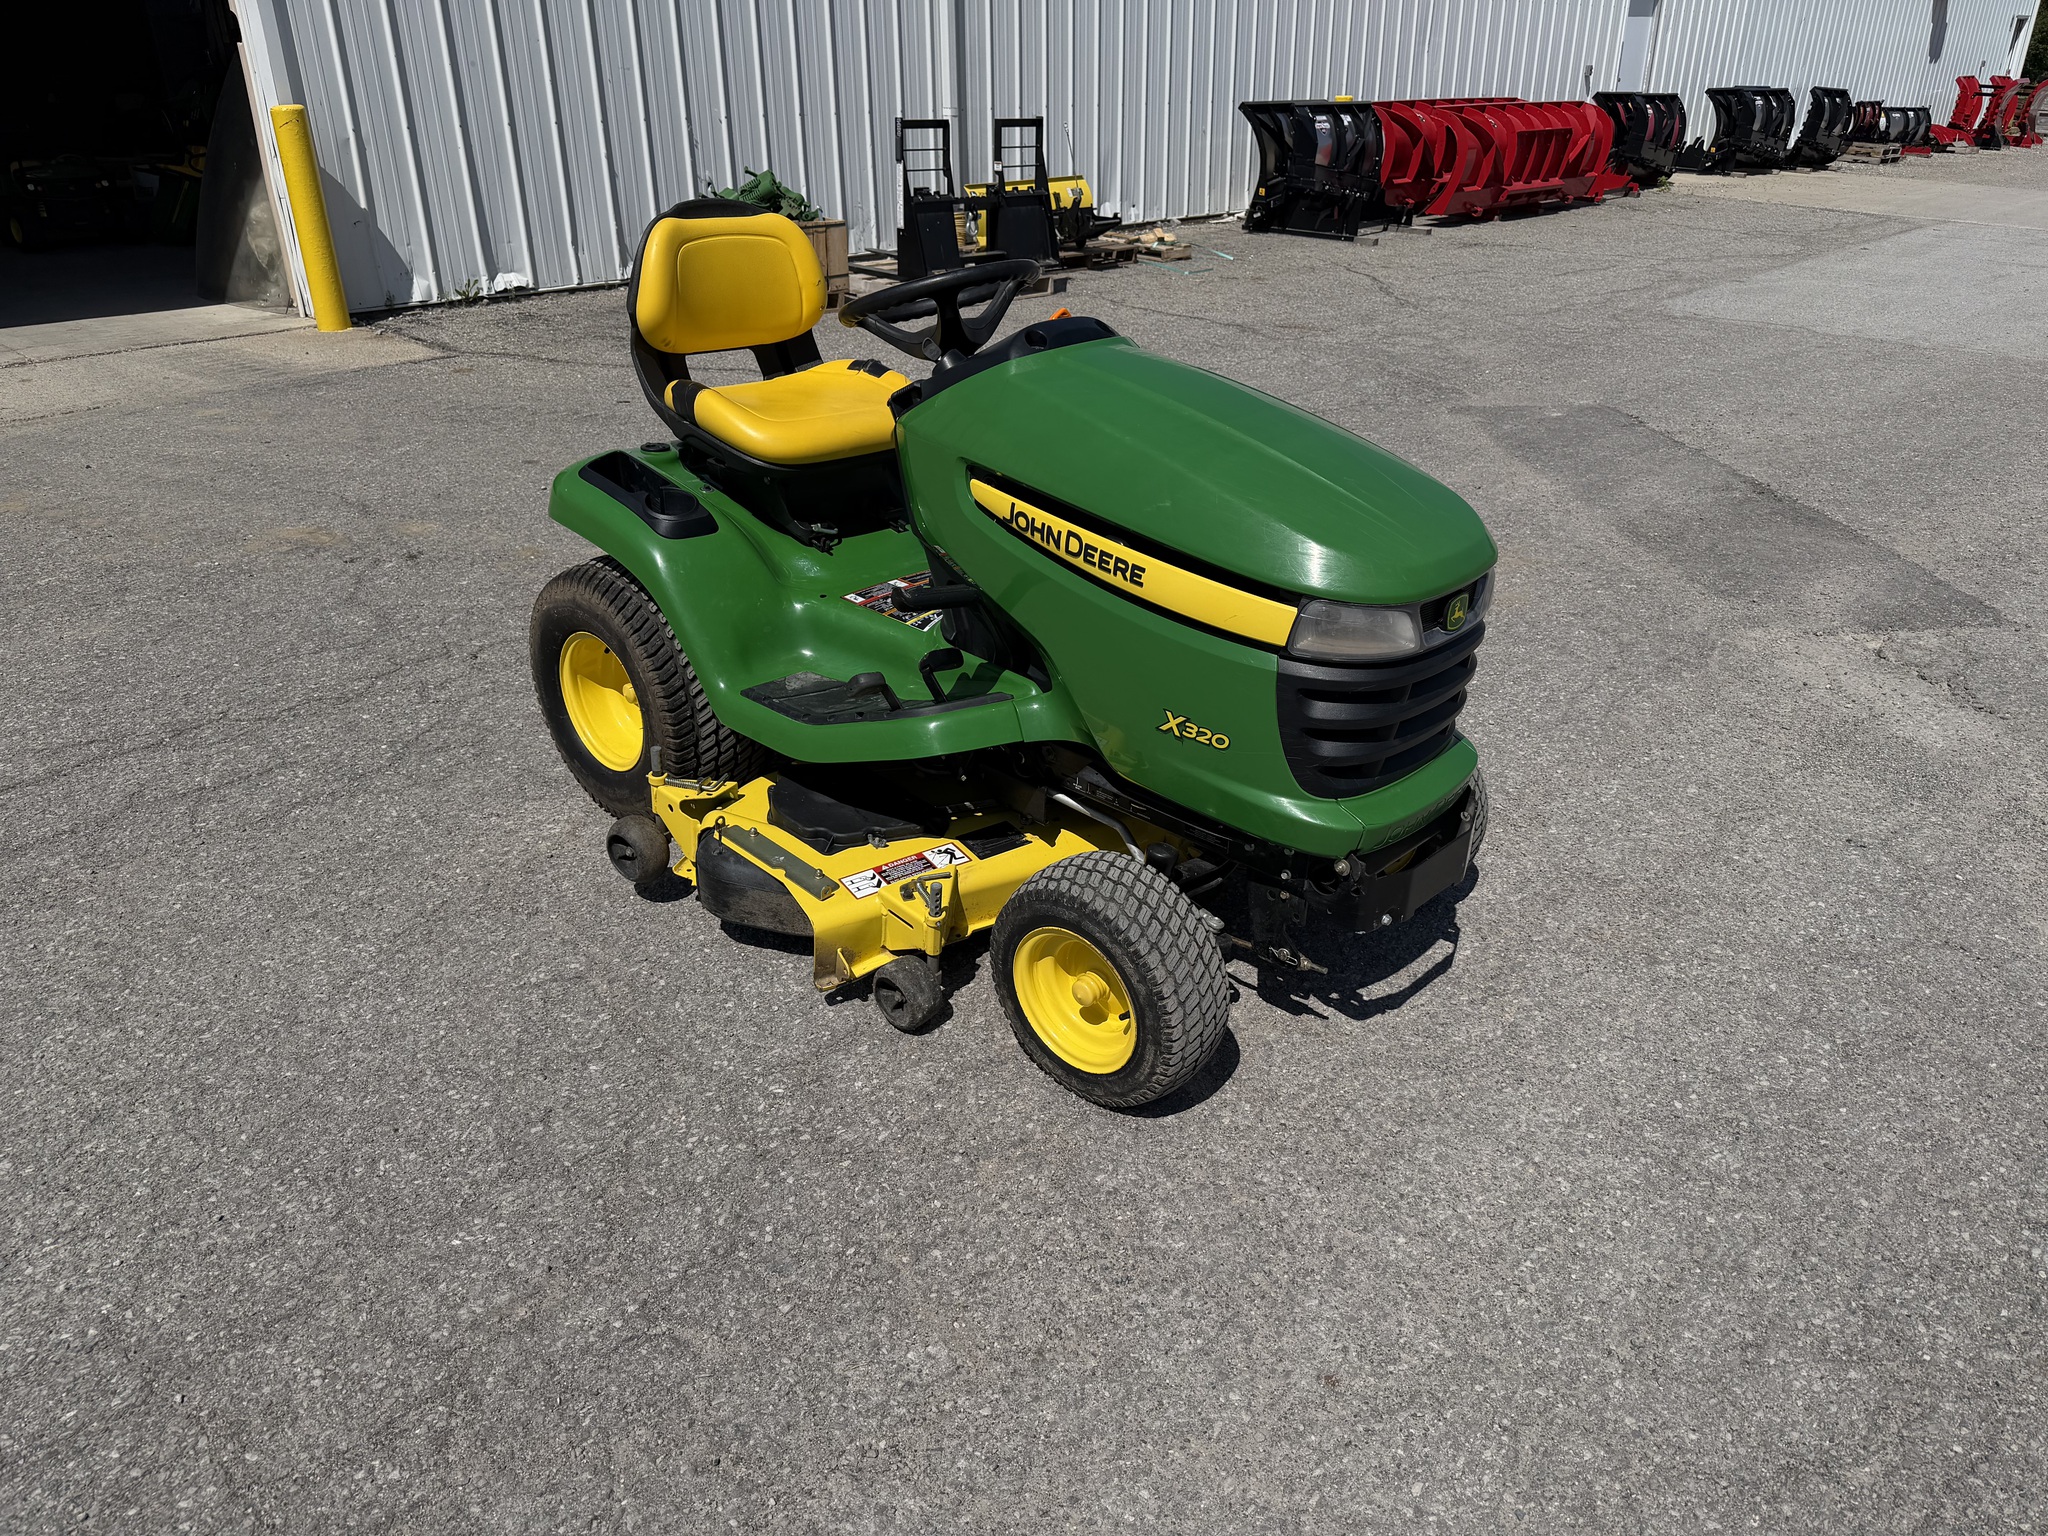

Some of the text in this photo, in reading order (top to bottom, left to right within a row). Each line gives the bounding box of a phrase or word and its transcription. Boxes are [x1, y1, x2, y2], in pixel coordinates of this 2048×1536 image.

[1002, 502, 1146, 588] JOHN DEERE
[1156, 708, 1231, 750] X320
[887, 855, 918, 868] DANGER
